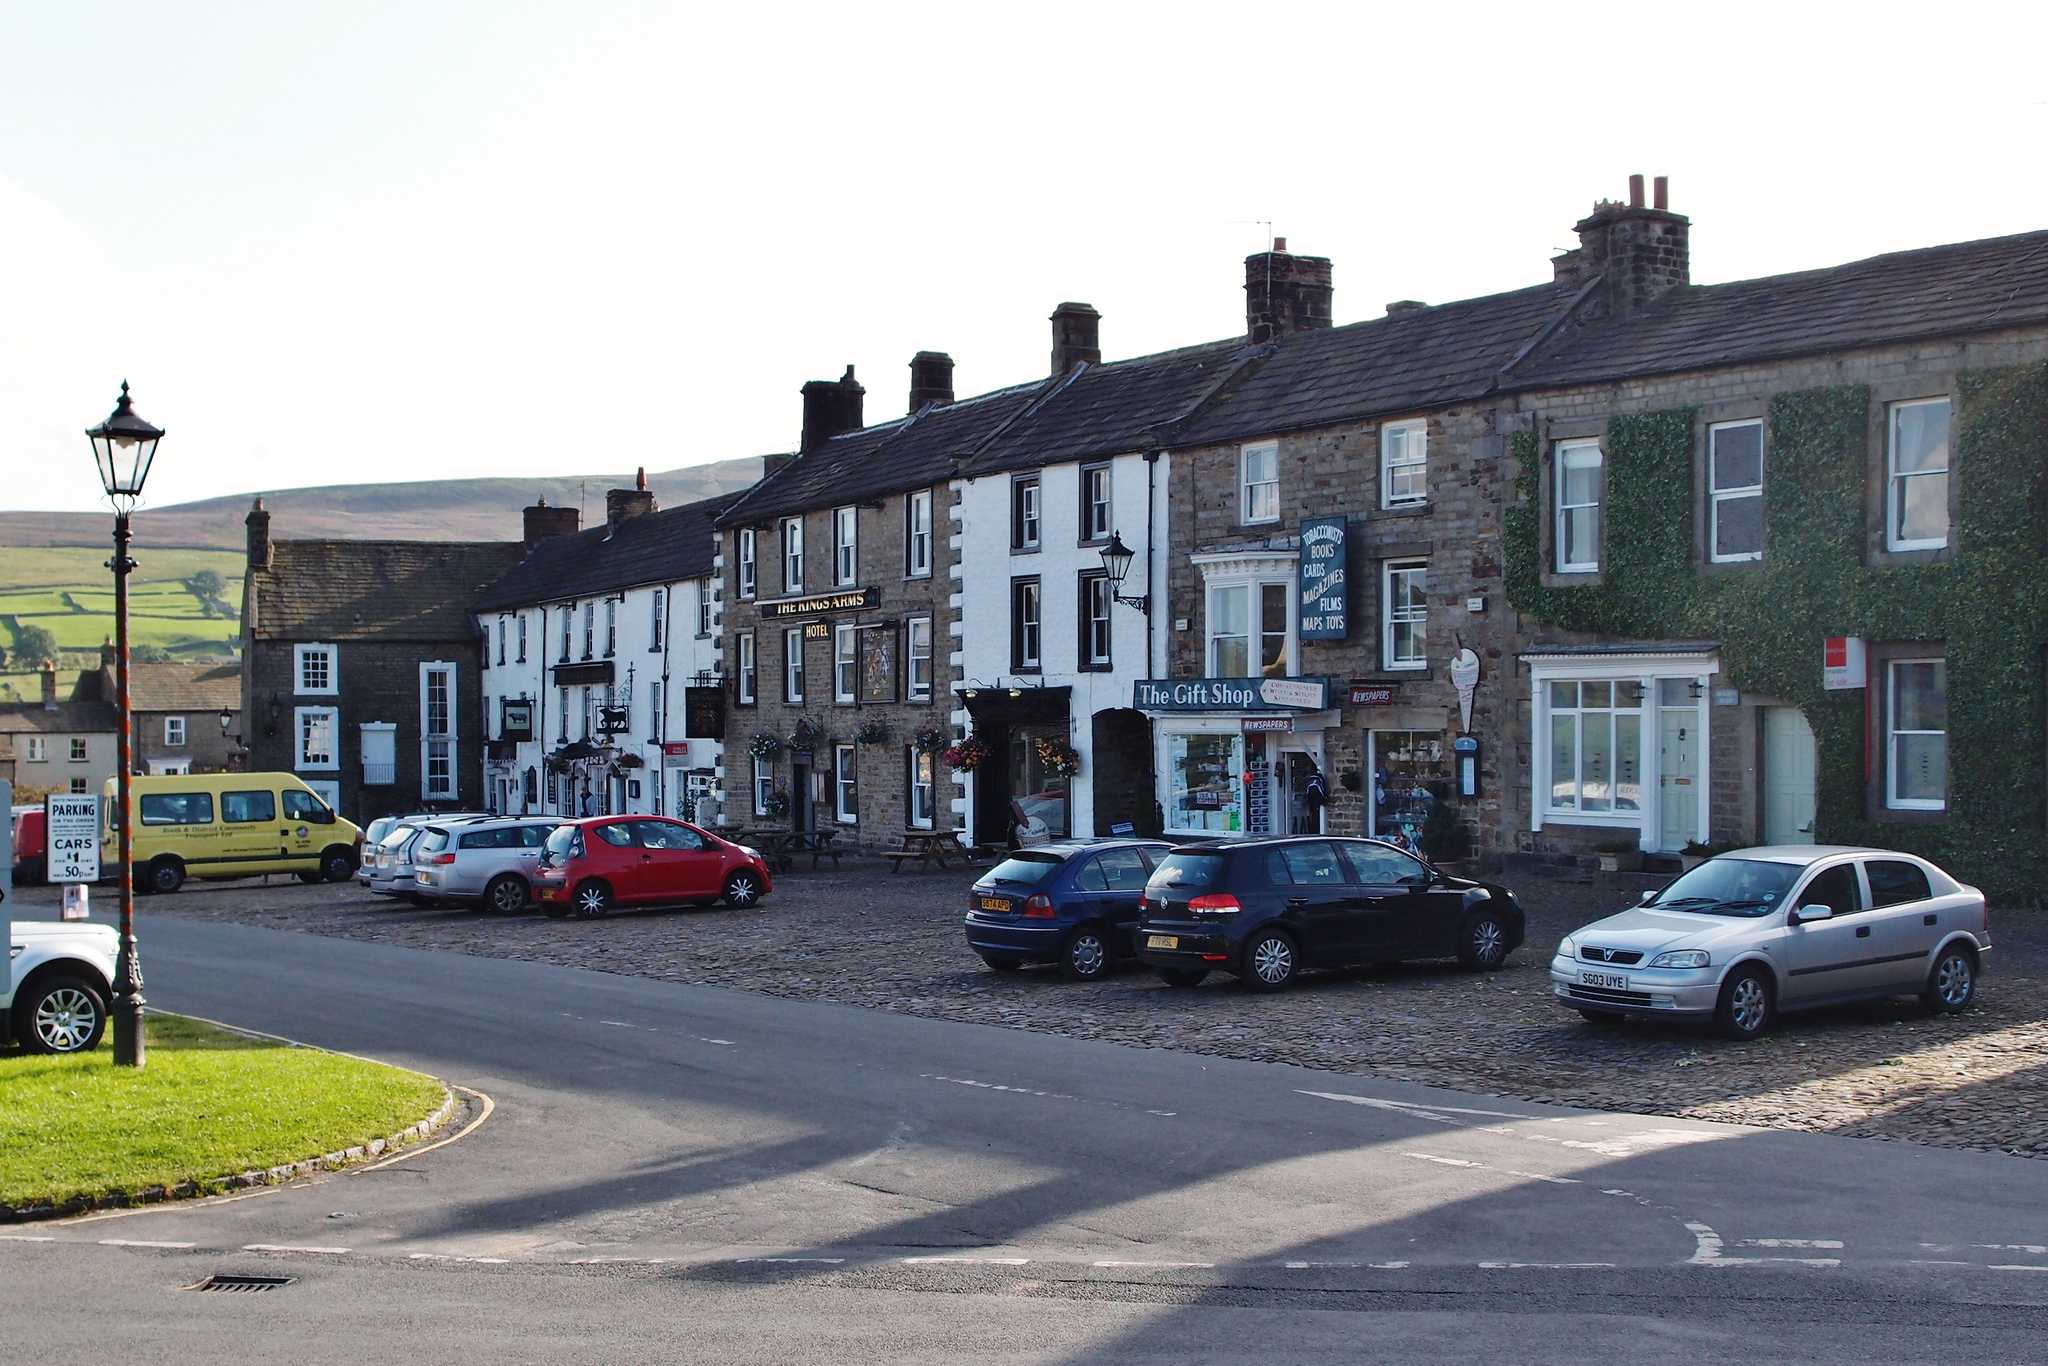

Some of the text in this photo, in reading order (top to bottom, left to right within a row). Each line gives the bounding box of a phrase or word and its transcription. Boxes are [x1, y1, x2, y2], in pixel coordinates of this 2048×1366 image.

[1303, 525, 1344, 546] TOBACCONISTS
[1311, 544, 1335, 559] BOOKS
[1303, 562, 1326, 578] CARDS
[1303, 568, 1344, 605] MAGAZINES
[777, 592, 865, 614] THE KINGS ARMS
[1320, 597, 1342, 611] FILMS
[1303, 615, 1344, 631] MAPS TOYS
[805, 624, 828, 638] HOTEL
[1140, 684, 1170, 705] The
[1174, 683, 1208, 705] Gift
[1211, 683, 1254, 708] Shop
[1244, 719, 1289, 730] NEWSPAPERS
[52, 804, 95, 817] PARKING
[54, 839, 92, 849] CARS
[1606, 976, 1624, 988] UYE
